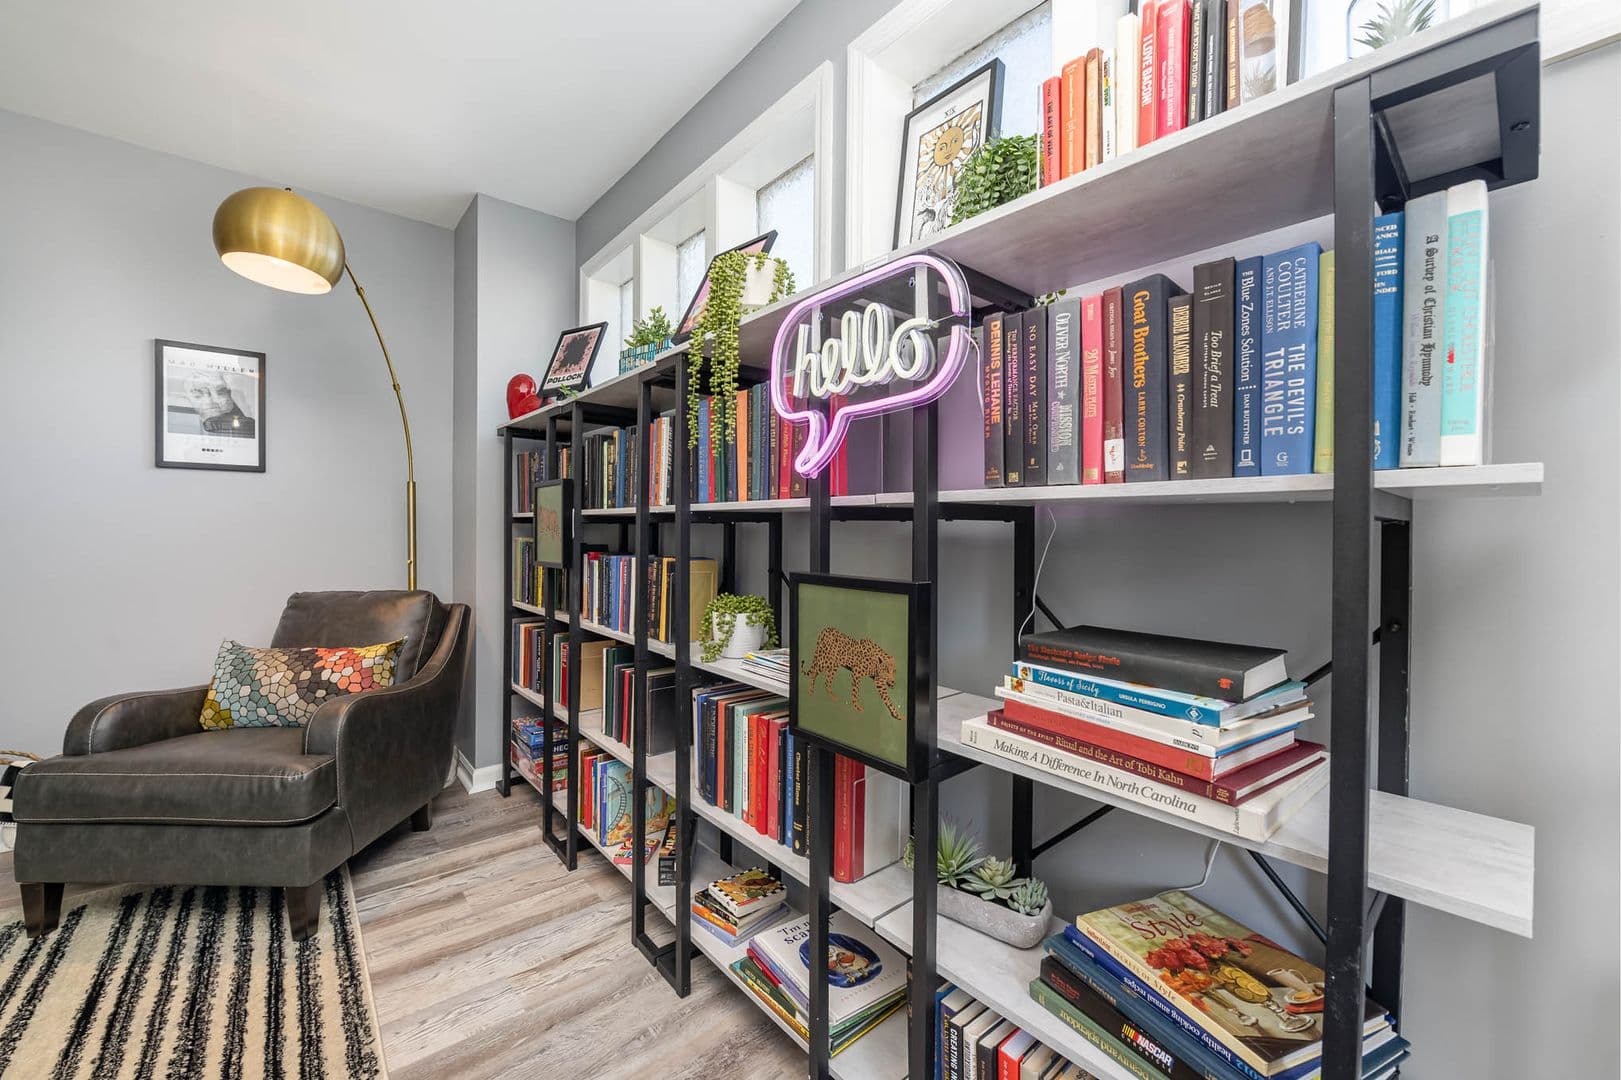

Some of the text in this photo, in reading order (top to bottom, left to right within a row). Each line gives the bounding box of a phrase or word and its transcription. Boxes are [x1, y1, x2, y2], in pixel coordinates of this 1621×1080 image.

[1142, 34, 1152, 107] I LOVE BACON!
[1240, 276, 1254, 302] Blue
[1266, 267, 1274, 334] AND J.T. ELLISON
[1278, 257, 1306, 332] CATHERINE COULTER
[1132, 290, 1150, 325] Goat
[1172, 306, 1190, 333] DEBBIE
[1240, 303, 1254, 336] Zones
[1418, 234, 1439, 386] A Survey of Christian Hymnody
[1028, 325, 1036, 341] NO
[1210, 331, 1222, 348] Too
[793, 302, 931, 399] hello
[1133, 326, 1150, 388] Brothers
[1172, 334, 1190, 375] MACOMBER
[1209, 350, 1222, 376] Brief
[1240, 338, 1254, 382] Solution
[546, 372, 584, 384] POLLOCK
[990, 320, 1000, 424] DENNIS LEHANE
[1054, 312, 1072, 446] OLIVER NORTH MISSION
[1086, 364, 1098, 396] MASTER
[1087, 396, 1098, 418] PLOTS
[1138, 392, 1146, 416] LARRY
[1210, 384, 1222, 408] Treat
[1243, 394, 1251, 408] DAN
[1264, 344, 1306, 438] THE DEVIL'S TRIANGLE
[1175, 394, 1186, 430] Cranberry
[1242, 409, 1251, 445] BUETTNER
[1177, 432, 1186, 452] Point
[1066, 676, 1076, 690] of
[1076, 676, 1100, 696] Sicily
[1118, 694, 1166, 709] URSULA FERRIGNO
[994, 738, 1029, 760] Making
[1030, 752, 1038, 762] A
[1040, 754, 1092, 779] Difference
[1093, 768, 1106, 784] In
[1108, 773, 1139, 797] North
[1140, 785, 1198, 814] Carolina
[1055, 736, 1078, 752] Ritual
[1078, 746, 1094, 756] and
[1094, 748, 1109, 760] the
[1110, 752, 1124, 770] Art
[1124, 758, 1136, 771] of
[1136, 760, 1156, 780] Tobi
[1158, 768, 1184, 786] Kahn
[1130, 912, 1204, 940] Style
[1122, 976, 1146, 996] recipes
[1147, 992, 1170, 1015] annual
[1170, 1009, 1200, 1036] cooking
[1138, 1032, 1174, 1070] NASCAR
[1202, 1032, 1232, 1062] healthy
